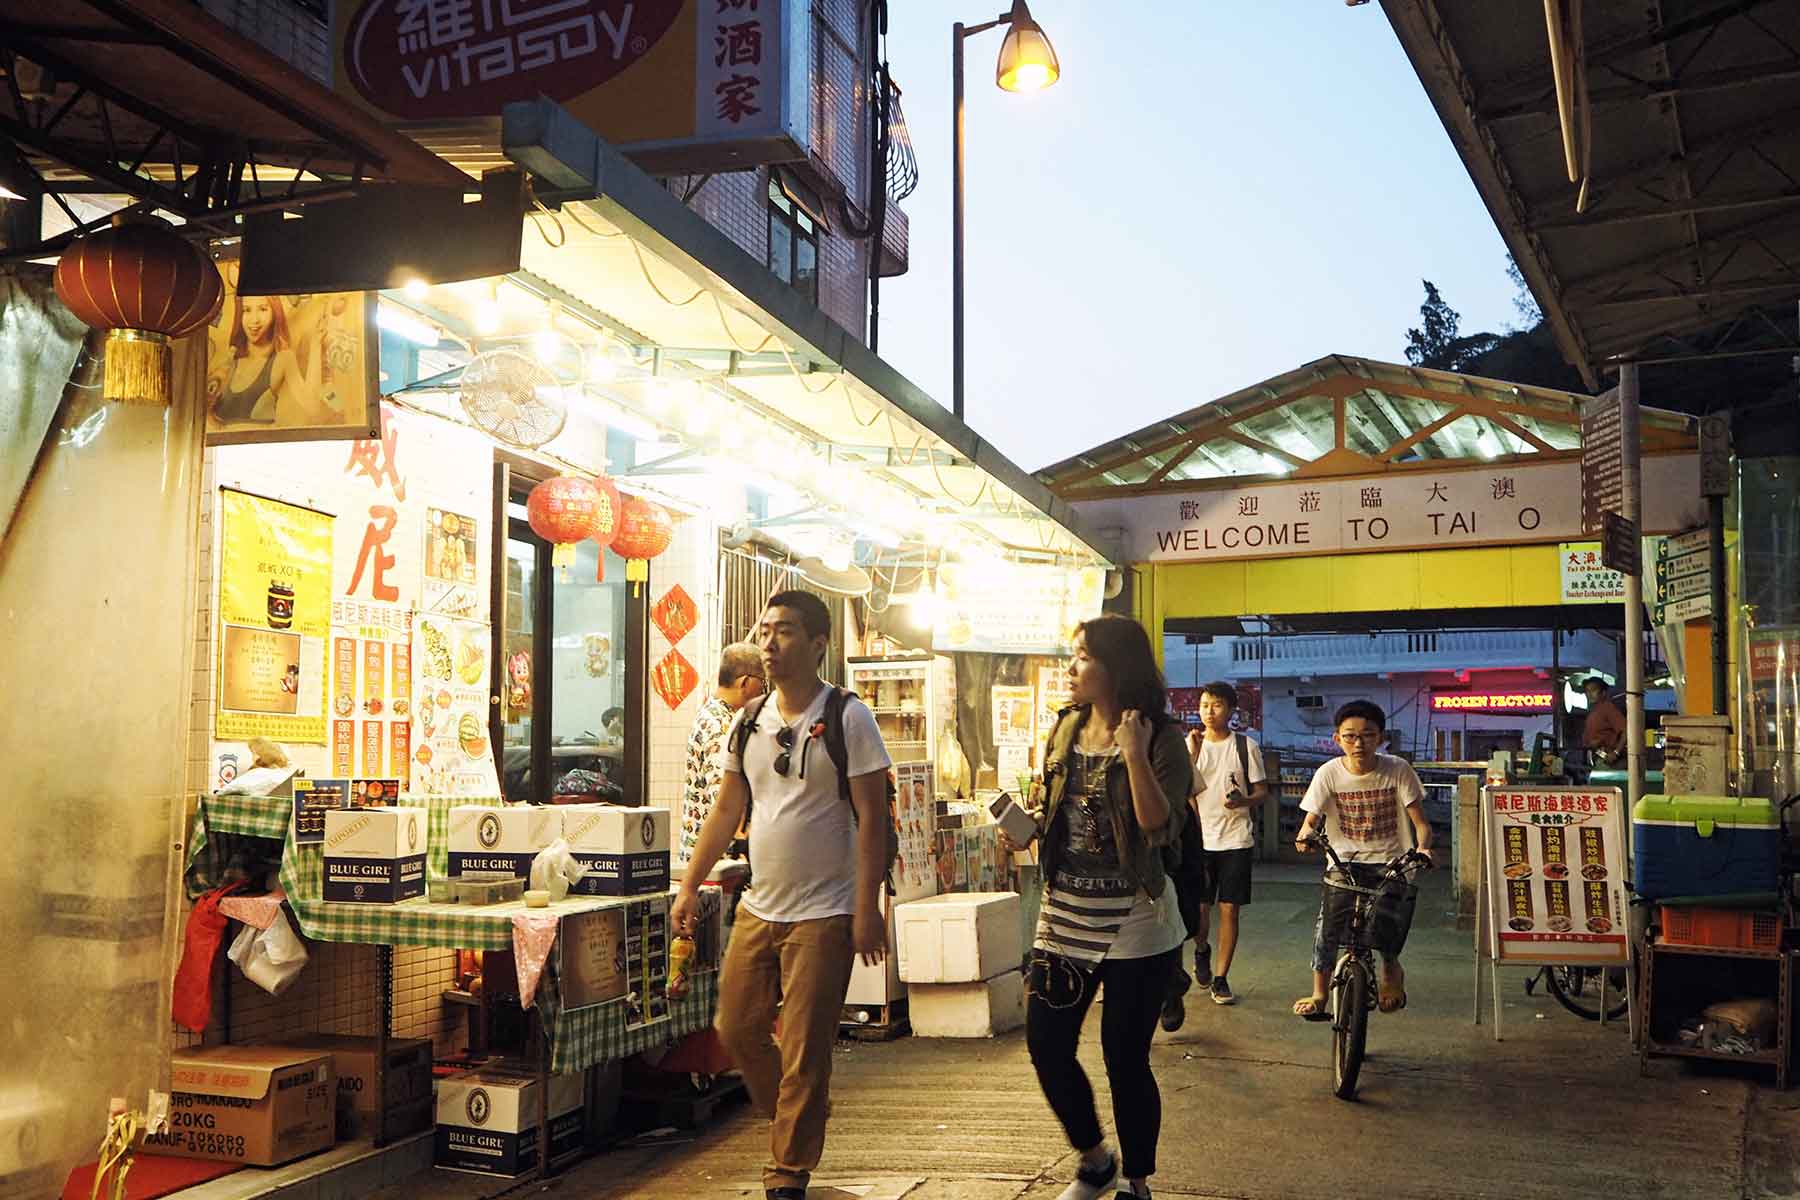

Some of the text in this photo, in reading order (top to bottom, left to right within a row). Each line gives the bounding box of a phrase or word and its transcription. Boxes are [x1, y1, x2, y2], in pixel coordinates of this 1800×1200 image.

[1157, 507, 1541, 552] WELCOME TO TAI O
[1568, 552, 1600, 565] 大澳
[1434, 695, 1552, 708] FROZEN FACTORY
[330, 864, 390, 876] BLUE GIRL
[461, 859, 515, 869] BLUE GIRL
[595, 860, 619, 871] GIRL
[173, 1111, 216, 1129] 20KG
[188, 1130, 245, 1146] TOKORO
[449, 1132, 503, 1149] BLUE GIRL
